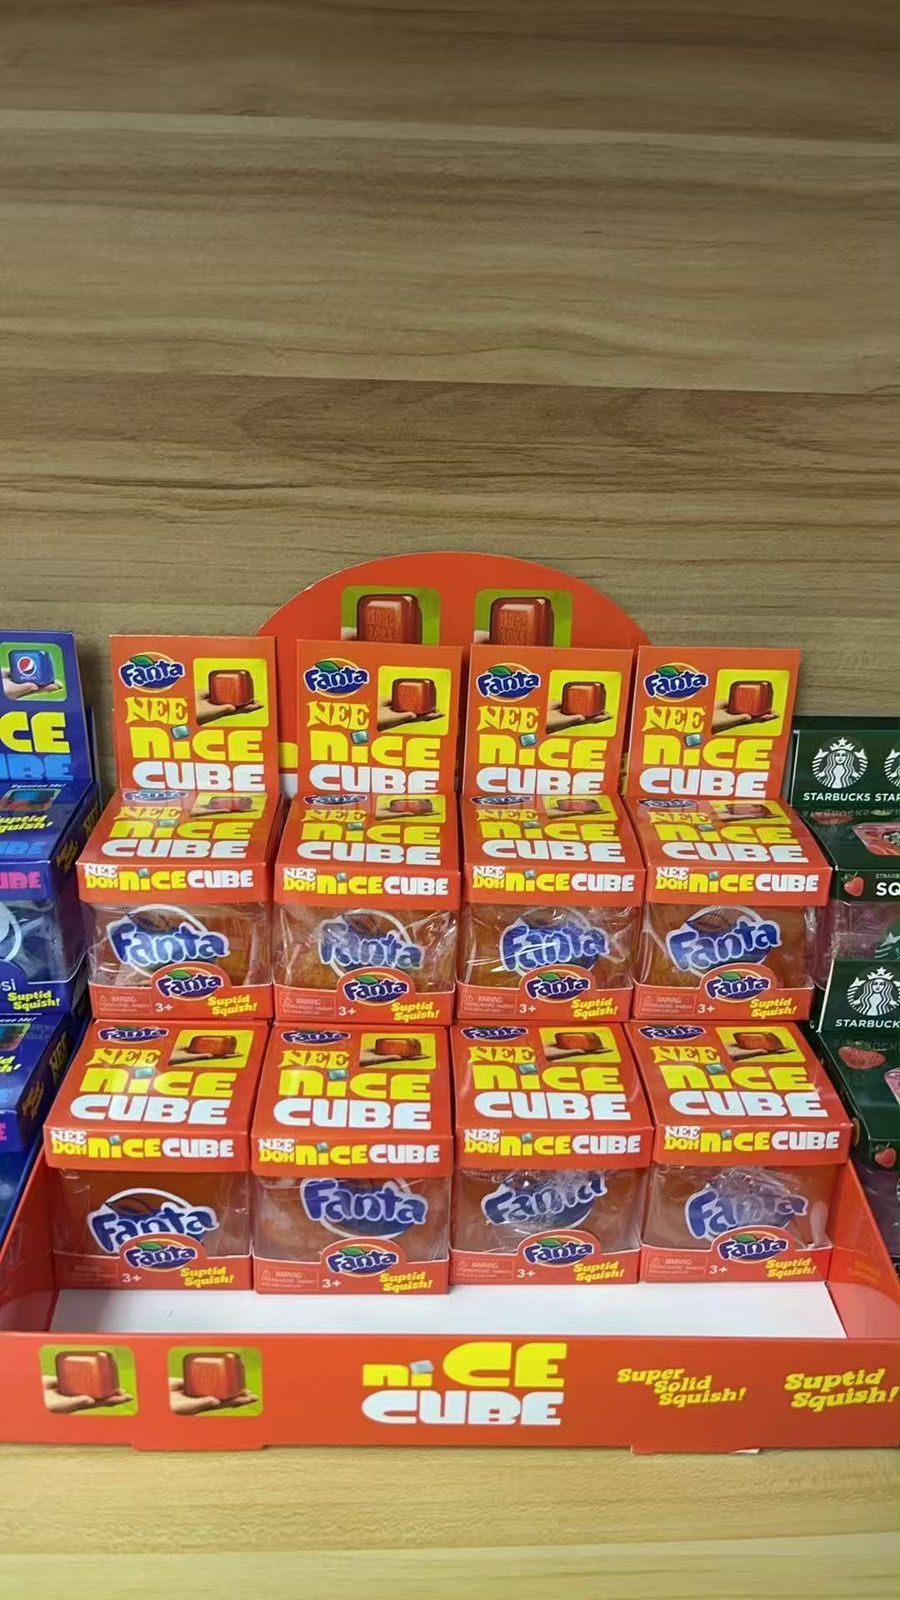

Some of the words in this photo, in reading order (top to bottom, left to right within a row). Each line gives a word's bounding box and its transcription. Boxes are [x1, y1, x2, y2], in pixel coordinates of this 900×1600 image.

[119, 659, 185, 688] Fanta
[304, 667, 369, 694] Fanta
[477, 670, 540, 697] Fanta
[643, 671, 709, 698] Fanta
[125, 697, 189, 725] NEE
[307, 701, 370, 730] NEE
[477, 706, 539, 734] NEE
[641, 706, 706, 733] NEE
[132, 761, 266, 791] CUBE
[309, 764, 440, 794] CUBE
[476, 767, 604, 795] CUBE
[639, 768, 767, 798] CUBE
[803, 792, 871, 801] STARBUCKS
[0, 815, 47, 825] uptid
[114, 806, 183, 820] NEE
[301, 809, 367, 823] NEE
[476, 809, 539, 822] NEE
[648, 812, 712, 824] NEE
[101, 839, 250, 859] CUBE
[297, 841, 441, 866] CUBE
[481, 839, 626, 863] CUBE
[661, 842, 809, 863] CUBE
[187, 870, 254, 889] CUBE
[384, 877, 449, 895] CUBE
[571, 873, 635, 892] CUBE
[755, 874, 819, 892] CUBE
[875, 881, 900, 896] SQ
[107, 922, 231, 966] Fanta
[500, 924, 609, 972] Fanta
[666, 917, 782, 972] Fanta
[0, 979, 16, 991] si
[156, 973, 223, 997] Fanta
[343, 980, 409, 1001] Fanta
[526, 976, 590, 998] Fanta
[705, 977, 771, 999] Fanta
[7, 990, 52, 1002] Suptid
[13, 998, 60, 1011] Squish!
[207, 994, 250, 1006] Suptid
[570, 998, 613, 1010] Suptid
[749, 998, 792, 1009] Suptid
[155, 1002, 173, 1013] 3+
[212, 1002, 258, 1017] Squish!
[339, 1006, 357, 1016] 3+
[390, 1002, 434, 1014] Suptid
[393, 1009, 440, 1023] Squish!
[519, 1004, 537, 1014] 3+
[573, 1005, 619, 1019] Squish!
[697, 1004, 715, 1014] 3+
[751, 1005, 797, 1019] Squish!
[835, 1019, 900, 1028] STARBUCK
[98, 1027, 169, 1041] Fanta
[86, 1048, 161, 1067] NEE
[278, 1050, 350, 1069] NEE
[468, 1046, 535, 1064] NEE
[650, 1046, 720, 1064] NEE
[70, 1095, 231, 1125] CUBE
[273, 1098, 431, 1130] CUBE
[474, 1092, 631, 1121] CUBE
[669, 1091, 828, 1118] CUBE
[162, 1138, 234, 1158] CUBE
[572, 1135, 641, 1154] CUBE
[771, 1131, 840, 1149] CUBE
[369, 1144, 440, 1164] CUBE
[301, 1178, 428, 1224] Fanta
[87, 1202, 219, 1253] Fanta
[124, 1247, 197, 1267] Fanta
[524, 1243, 594, 1264] Fanta
[718, 1238, 789, 1260] Fanta
[327, 1250, 398, 1272] Fanta
[573, 1260, 619, 1273] Suptid
[709, 1265, 728, 1274] 3+
[765, 1258, 812, 1270] Suptid
[122, 1273, 142, 1283] 3+
[180, 1266, 227, 1278] Suptid
[184, 1274, 234, 1288] Squish!
[379, 1272, 426, 1284] Suptid
[517, 1269, 536, 1278] 3+
[576, 1270, 625, 1283] Squish!
[767, 1266, 817, 1279] Squish!
[322, 1278, 341, 1288] 3+
[383, 1279, 433, 1293] Squish!
[617, 1368, 686, 1386] Super
[654, 1375, 712, 1393] Solid
[784, 1367, 886, 1394] Suptid
[658, 1387, 747, 1407] Squish!
[790, 1384, 899, 1412] Squish!
[361, 1389, 565, 1426] CUBE
